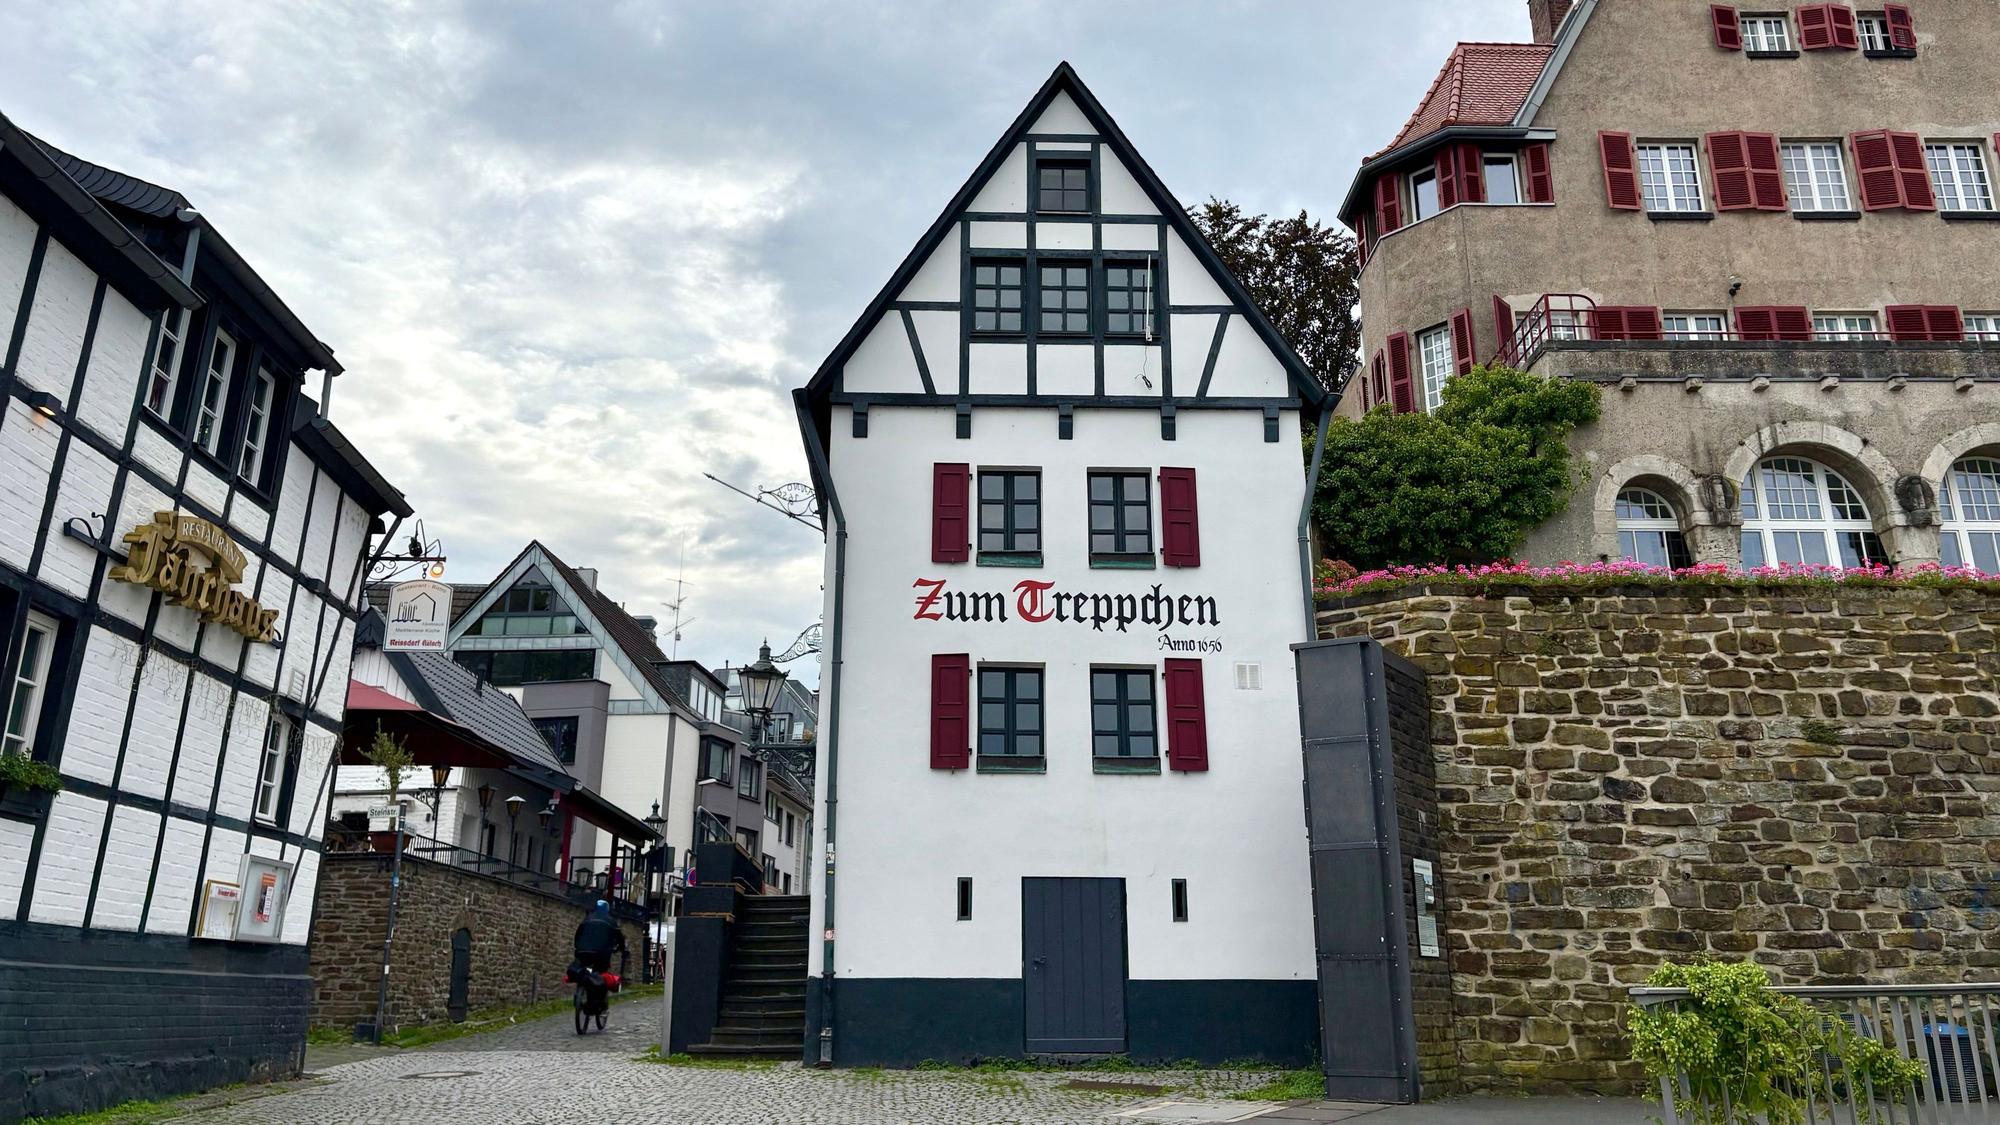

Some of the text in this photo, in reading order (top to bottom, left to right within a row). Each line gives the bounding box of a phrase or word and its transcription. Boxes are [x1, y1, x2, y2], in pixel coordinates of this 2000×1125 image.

[182, 521, 241, 567] RESTAURANT
[912, 578, 1221, 633] Zum Treppchen
[1157, 633, 1222, 655] Anno 1656
[369, 808, 398, 817] Steinstr.
